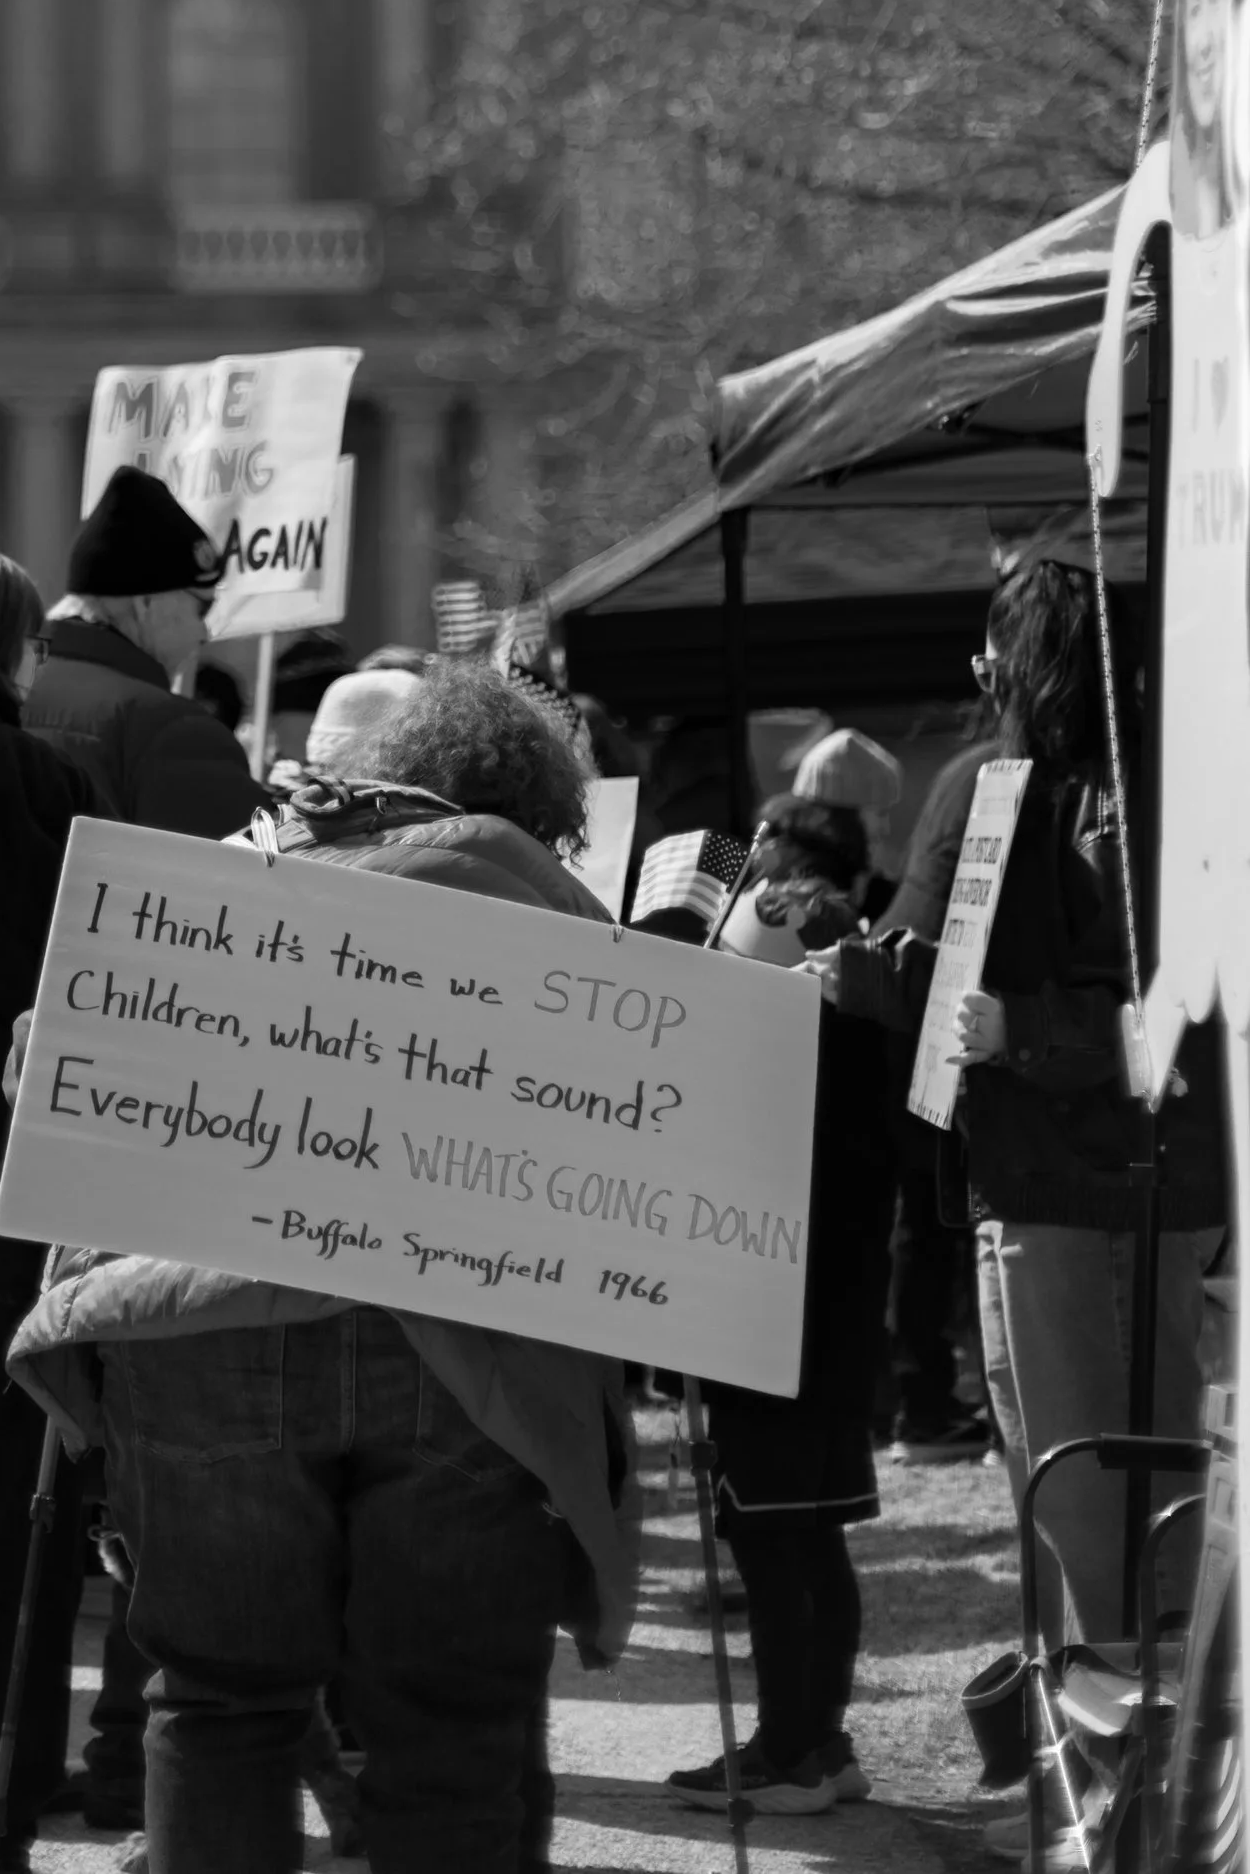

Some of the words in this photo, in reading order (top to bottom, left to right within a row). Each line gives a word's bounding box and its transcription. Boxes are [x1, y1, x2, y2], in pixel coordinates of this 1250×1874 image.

[220, 516, 328, 575] AGAIN
[87, 882, 109, 934] I
[132, 891, 234, 956] think
[255, 919, 305, 963] it's
[330, 931, 425, 989] time
[450, 977, 503, 1006] we
[534, 969, 687, 1049] STOP
[66, 970, 251, 1048] Children,
[269, 1004, 384, 1066] what's
[397, 1032, 494, 1091] that
[510, 1079, 683, 1133] sound?
[50, 1055, 283, 1170] Everybody
[296, 1096, 381, 1170] look
[401, 1131, 539, 1202] WHAT'S
[546, 1165, 673, 1237] GOING
[686, 1193, 803, 1265] DOWN
[402, 1231, 566, 1288] Springfield
[598, 1268, 671, 1306] 1966
